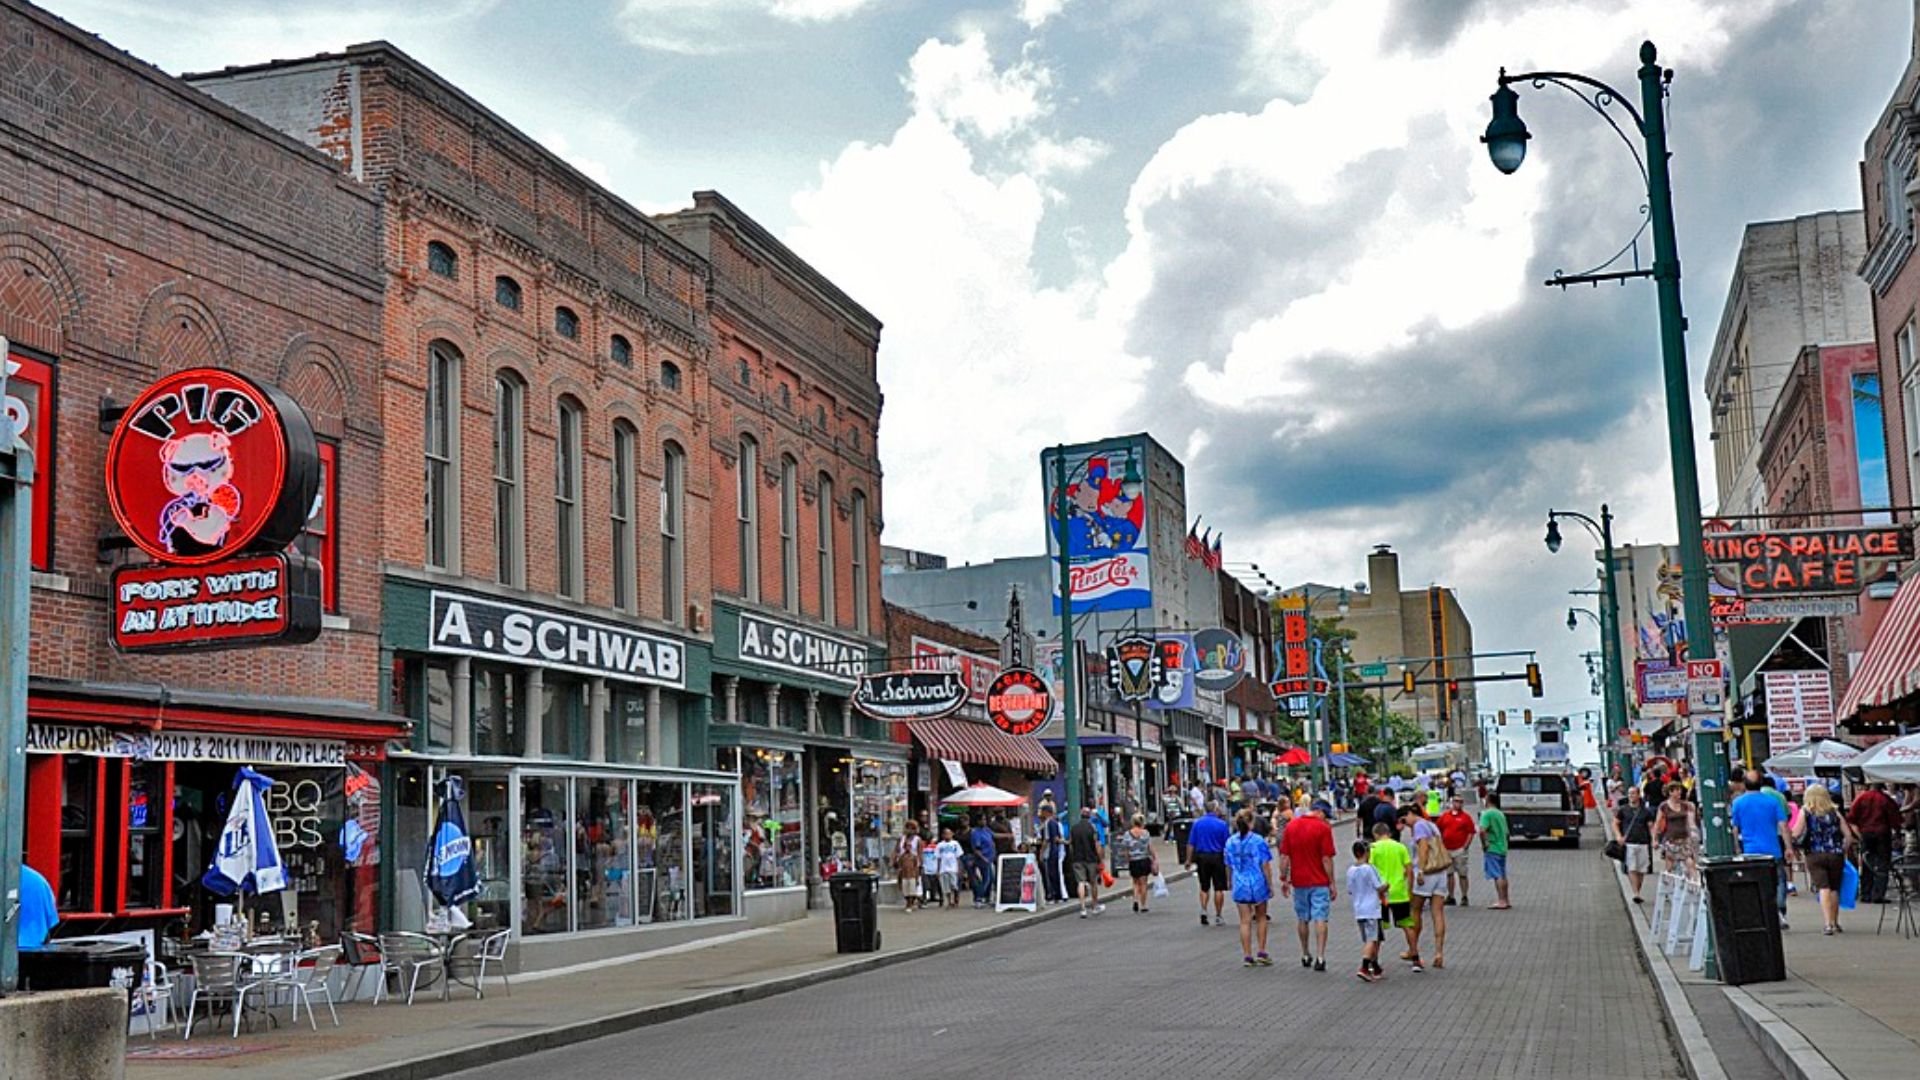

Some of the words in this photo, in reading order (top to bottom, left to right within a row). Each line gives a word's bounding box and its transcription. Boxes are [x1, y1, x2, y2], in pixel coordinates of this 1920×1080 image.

[129, 383, 261, 440] PIG
[1790, 532, 1899, 556] PALACE
[120, 577, 200, 603] PORK
[205, 570, 278, 595] WITH
[1744, 559, 1857, 589] CAFE
[120, 609, 157, 633] AN
[159, 596, 279, 630] ATTITUDE!
[1692, 664, 1716, 678] NO
[881, 675, 958, 702] Schwab
[989, 692, 1048, 713] RESTAURANT
[1275, 681, 1325, 696] KINGS
[26, 725, 113, 753] AMPION!
[153, 735, 190, 759] 2010
[192, 736, 202, 759] &
[207, 737, 242, 760] 2011
[244, 740, 273, 762] MIM
[275, 742, 301, 763] 2ND
[305, 743, 344, 765] PLACE
[267, 779, 323, 812] BQ
[273, 816, 323, 849] BS
